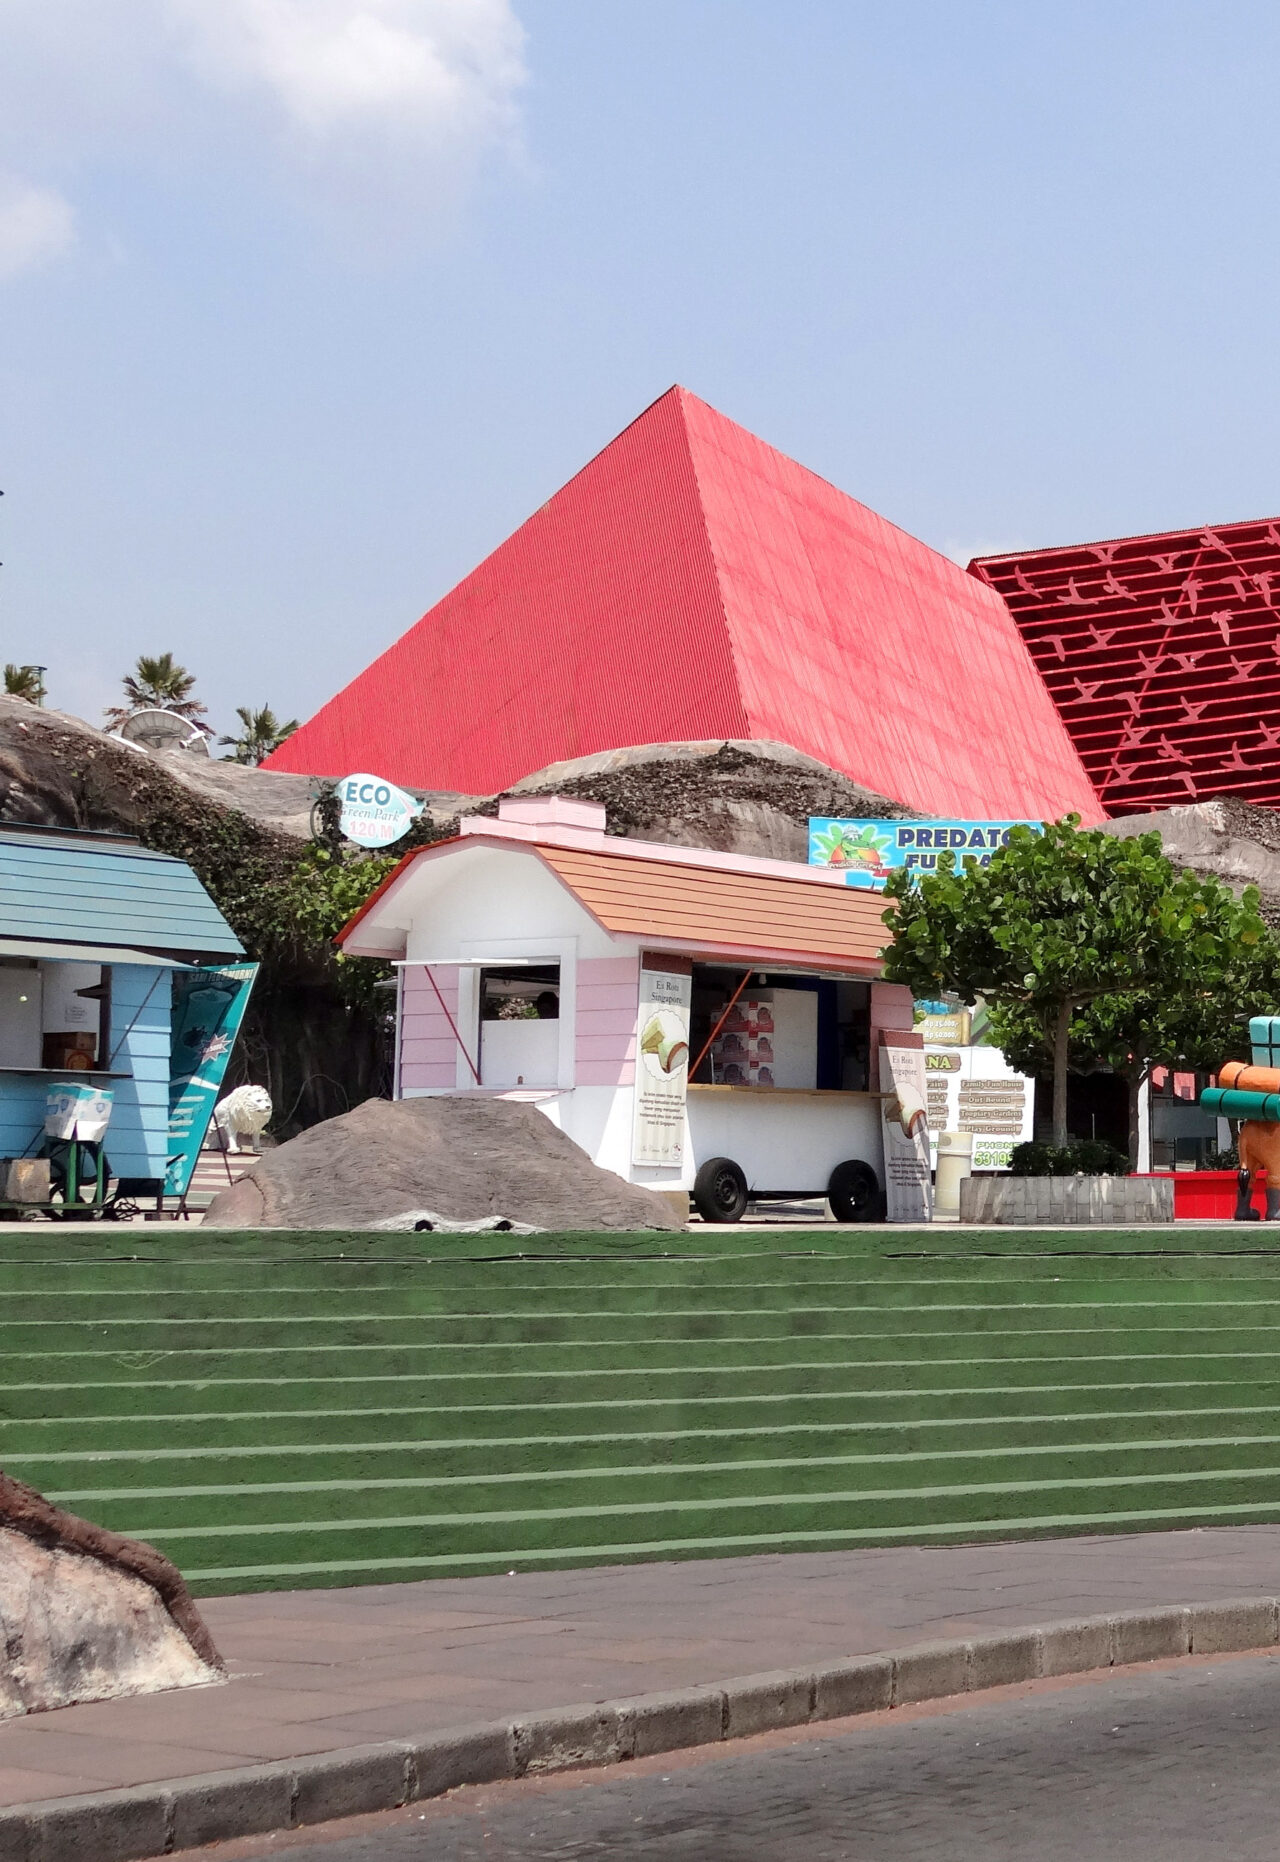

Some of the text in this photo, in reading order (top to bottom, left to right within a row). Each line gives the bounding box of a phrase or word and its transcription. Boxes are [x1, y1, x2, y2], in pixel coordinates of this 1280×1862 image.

[345, 781, 391, 806] ECO
[374, 808, 400, 822] Park
[350, 821, 393, 839] 120 M
[898, 828, 1040, 848] PREDAT
[986, 1080, 1001, 1088] Fun
[985, 1095, 1011, 1103] Bound
[966, 1125, 983, 1133] Play
